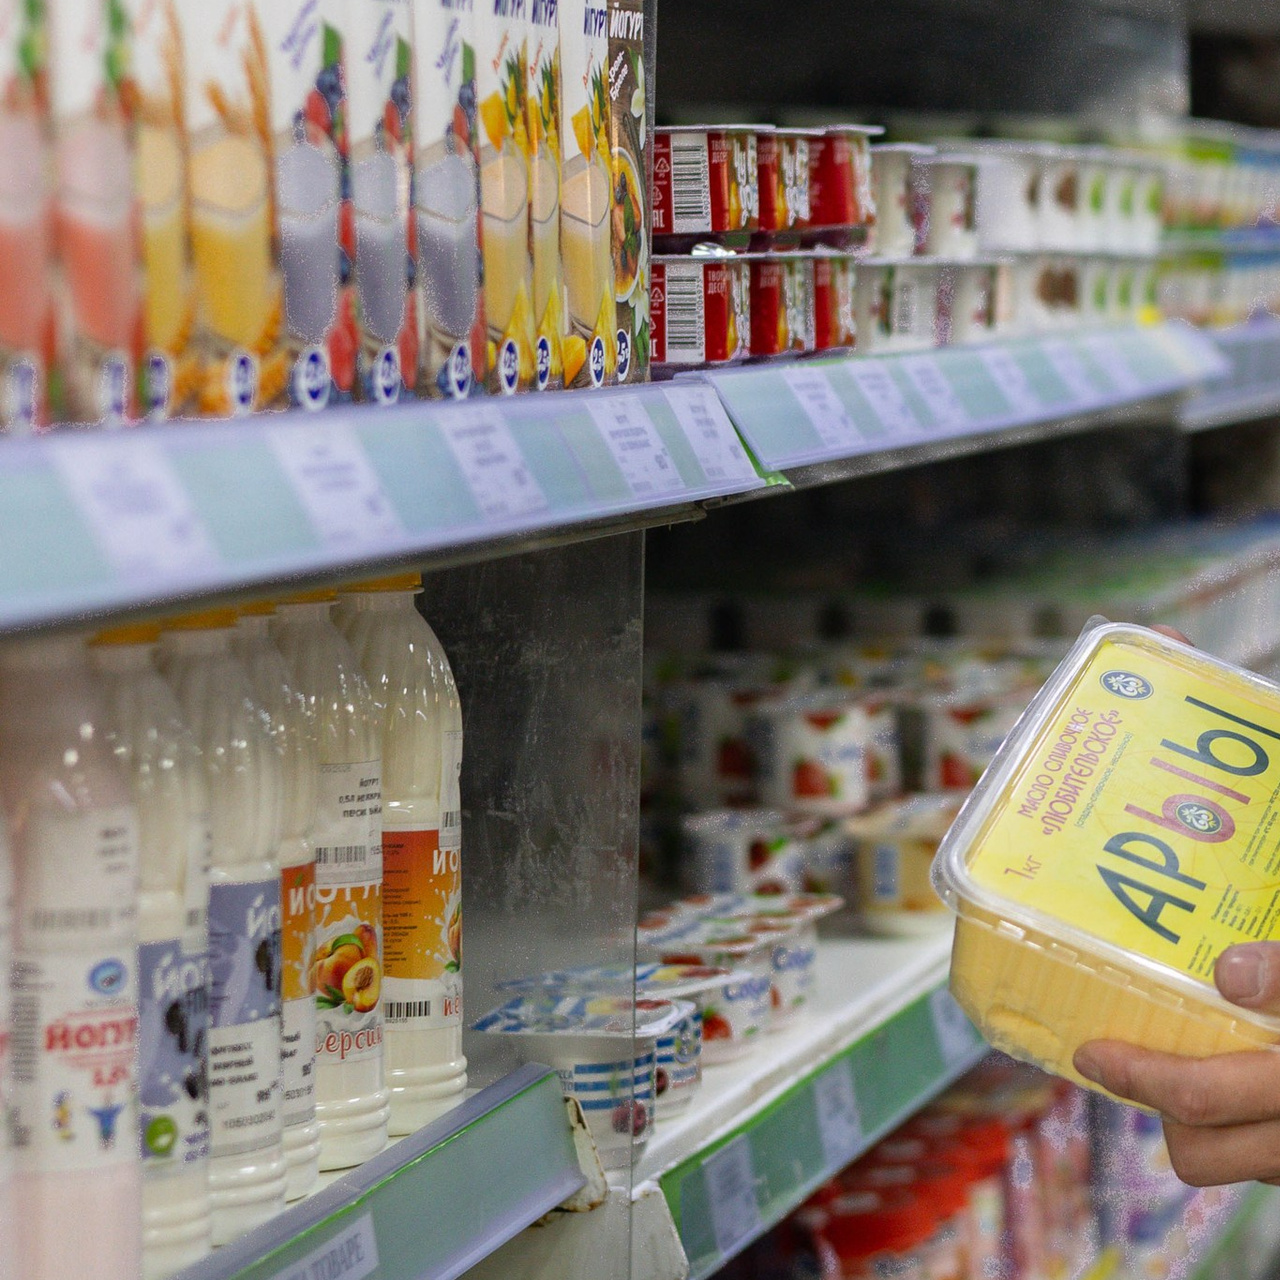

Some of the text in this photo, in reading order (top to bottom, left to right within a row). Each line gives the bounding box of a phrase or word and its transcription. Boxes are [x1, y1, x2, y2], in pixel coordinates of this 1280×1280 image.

[1017, 707, 1094, 819] МАСЛО СЛИВОЧНОЕ
[1041, 709, 1123, 836] «ЛЮБИТЕЛЬСКОЕ»
